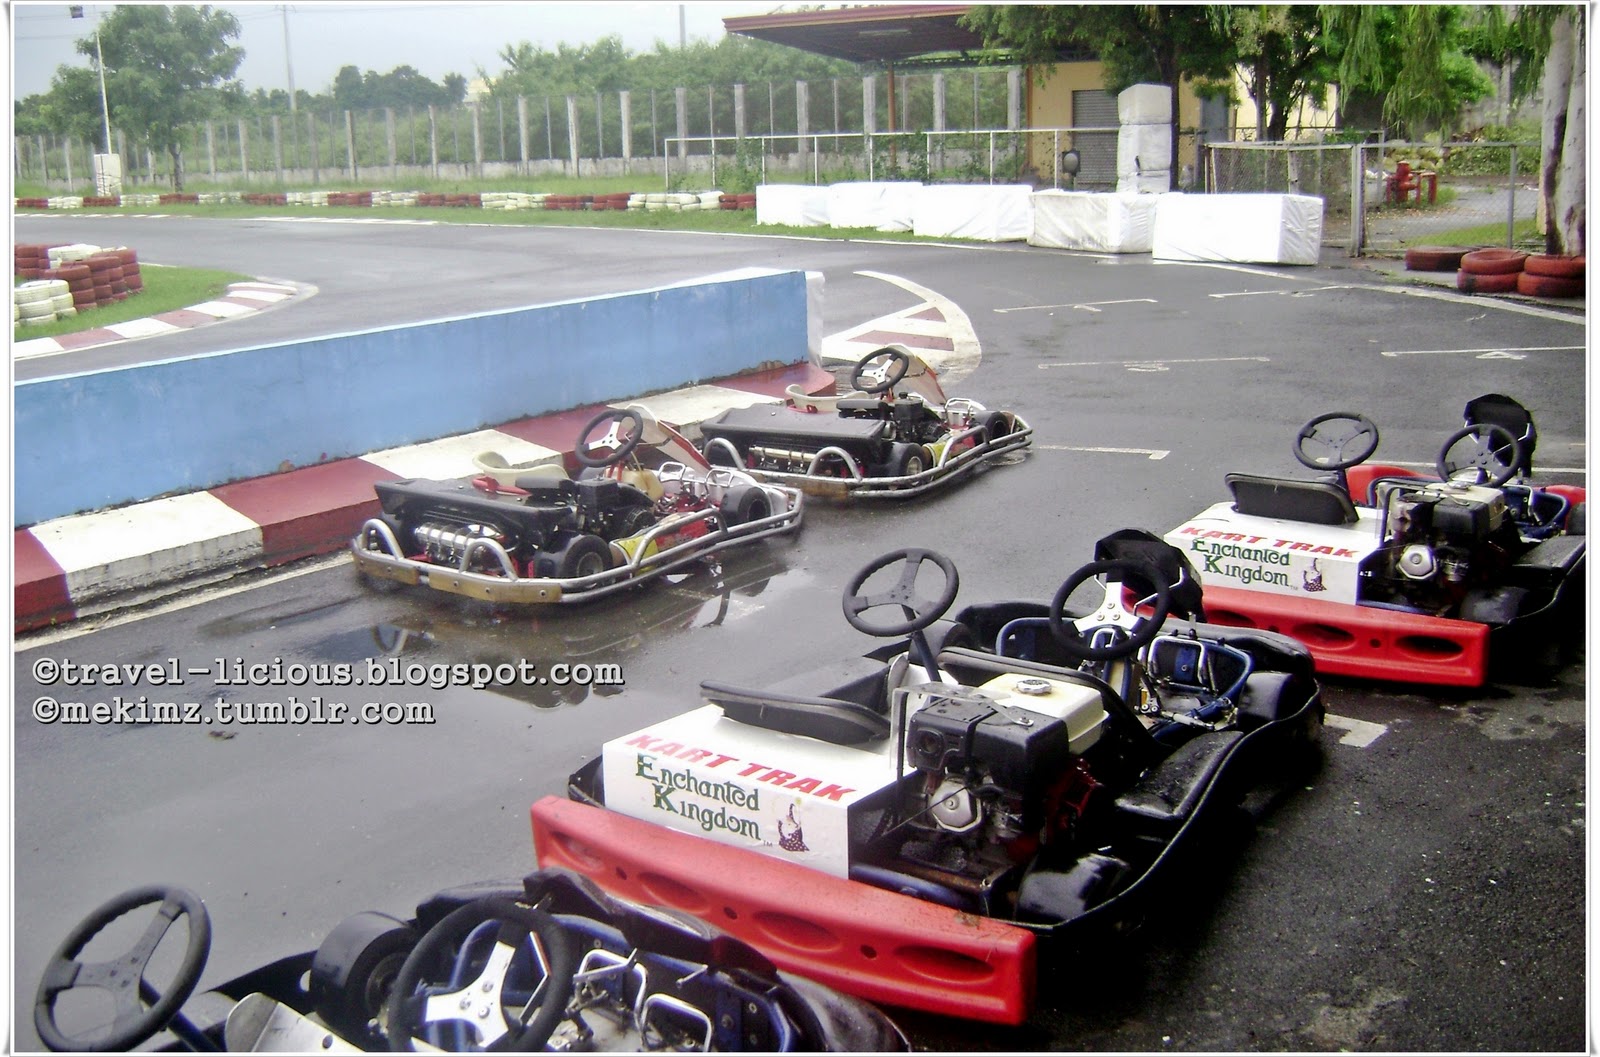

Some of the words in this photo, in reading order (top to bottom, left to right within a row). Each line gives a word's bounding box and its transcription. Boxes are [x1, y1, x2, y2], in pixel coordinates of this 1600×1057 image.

[1180, 527, 1269, 544] KART
[1272, 538, 1360, 558] TRAK
[1190, 537, 1290, 566] Enchanted
[1202, 554, 1290, 588] Kingdom
[626, 734, 740, 768] KART
[737, 762, 858, 802] TRAK
[635, 752, 760, 811] Enchanted
[653, 783, 762, 841] Kingdom
